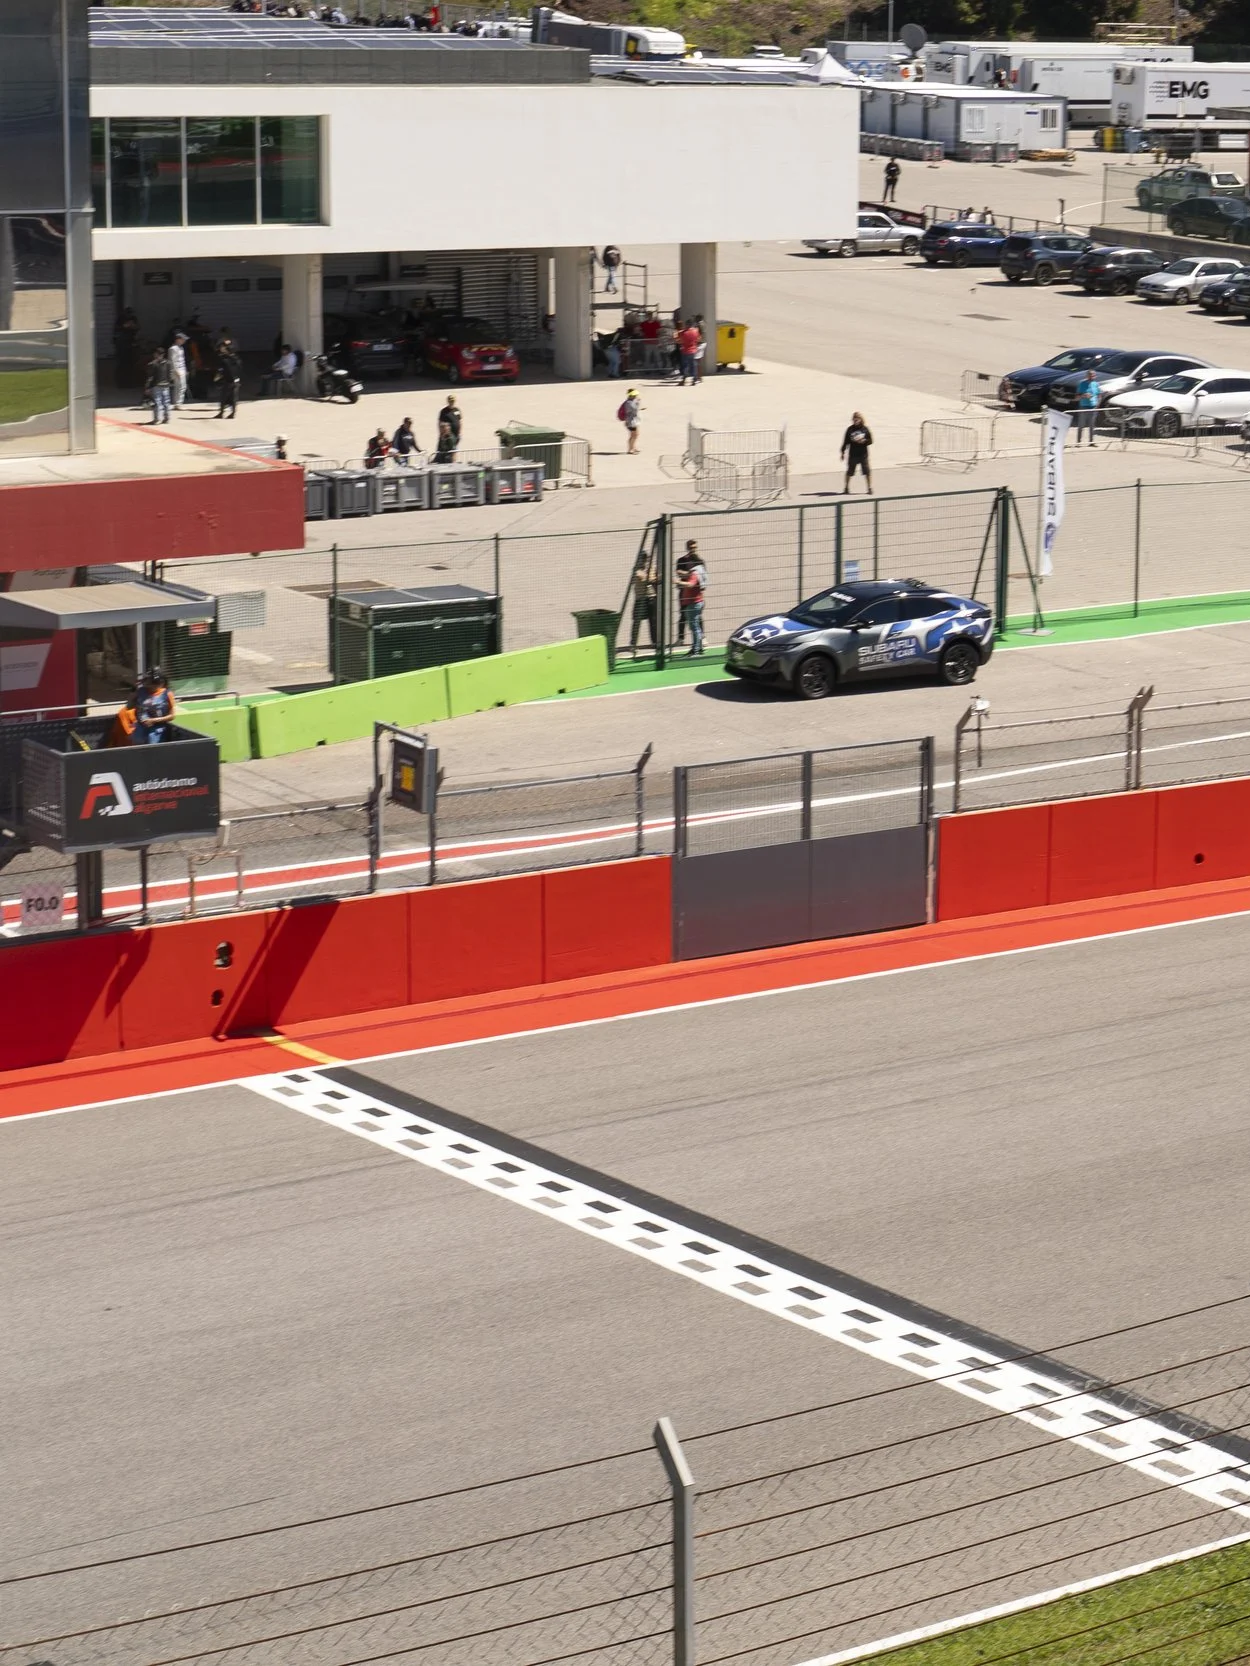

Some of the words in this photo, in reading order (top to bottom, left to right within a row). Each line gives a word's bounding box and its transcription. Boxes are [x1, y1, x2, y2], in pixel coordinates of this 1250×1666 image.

[1168, 80, 1210, 99] EMG
[857, 637, 917, 657] SUBARU
[895, 647, 917, 658] CAR
